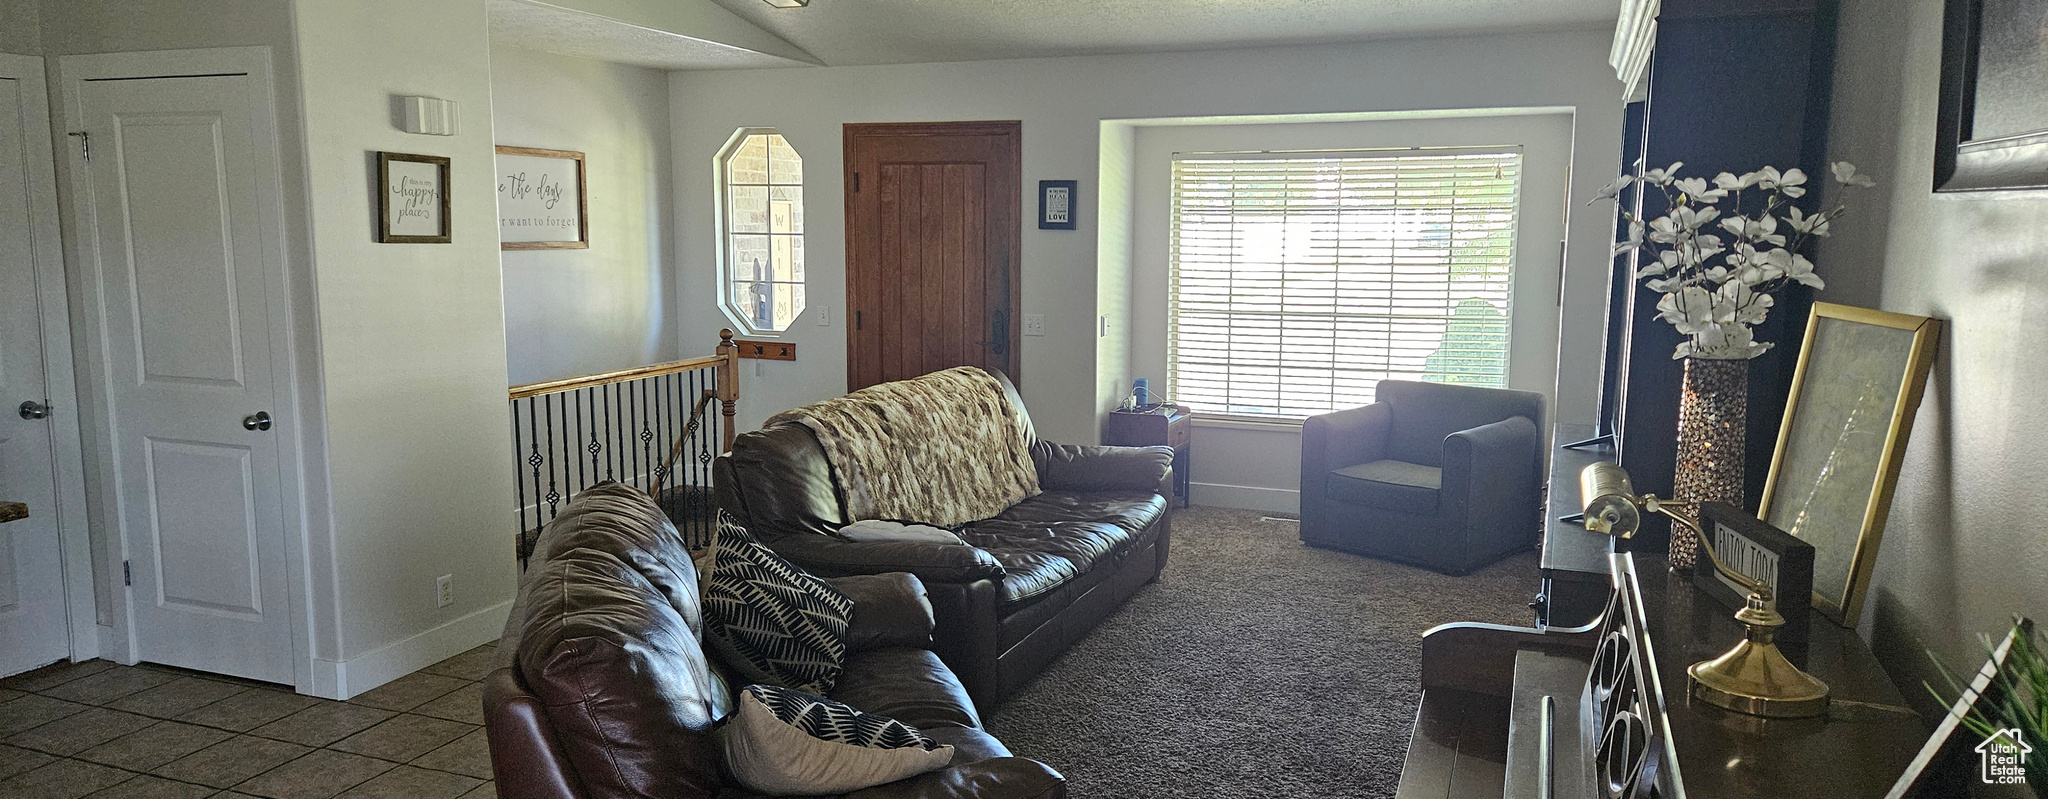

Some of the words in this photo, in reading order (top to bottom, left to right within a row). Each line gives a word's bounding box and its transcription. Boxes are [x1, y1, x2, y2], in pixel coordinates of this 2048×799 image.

[392, 175, 439, 208] happy
[507, 172, 531, 200] the
[536, 173, 562, 210] days
[397, 198, 430, 224] place
[508, 217, 532, 227] want
[534, 217, 544, 227] to
[546, 215, 575, 229] forget
[1750, 545, 1774, 594] TODA
